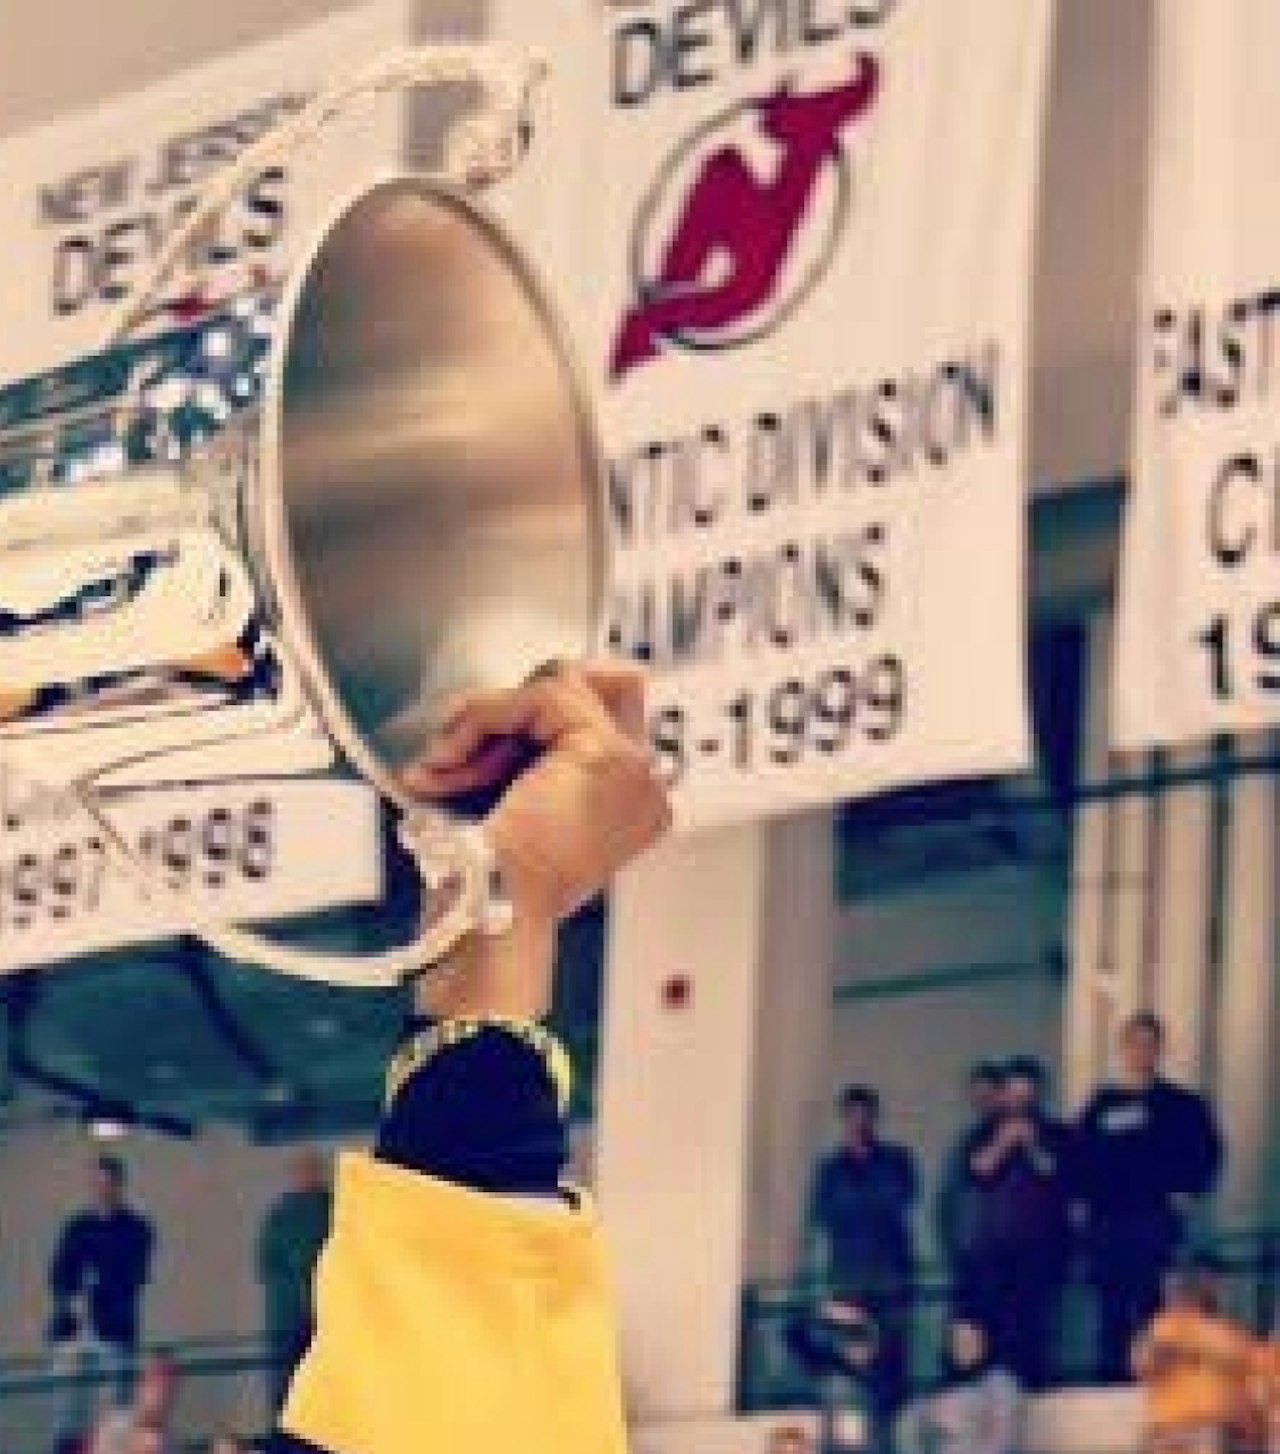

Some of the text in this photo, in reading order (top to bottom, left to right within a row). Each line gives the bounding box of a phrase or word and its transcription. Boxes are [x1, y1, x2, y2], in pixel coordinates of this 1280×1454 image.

[607, 340, 1000, 546] NTIC DIVISION
[608, 524, 887, 668] AMPIONS
